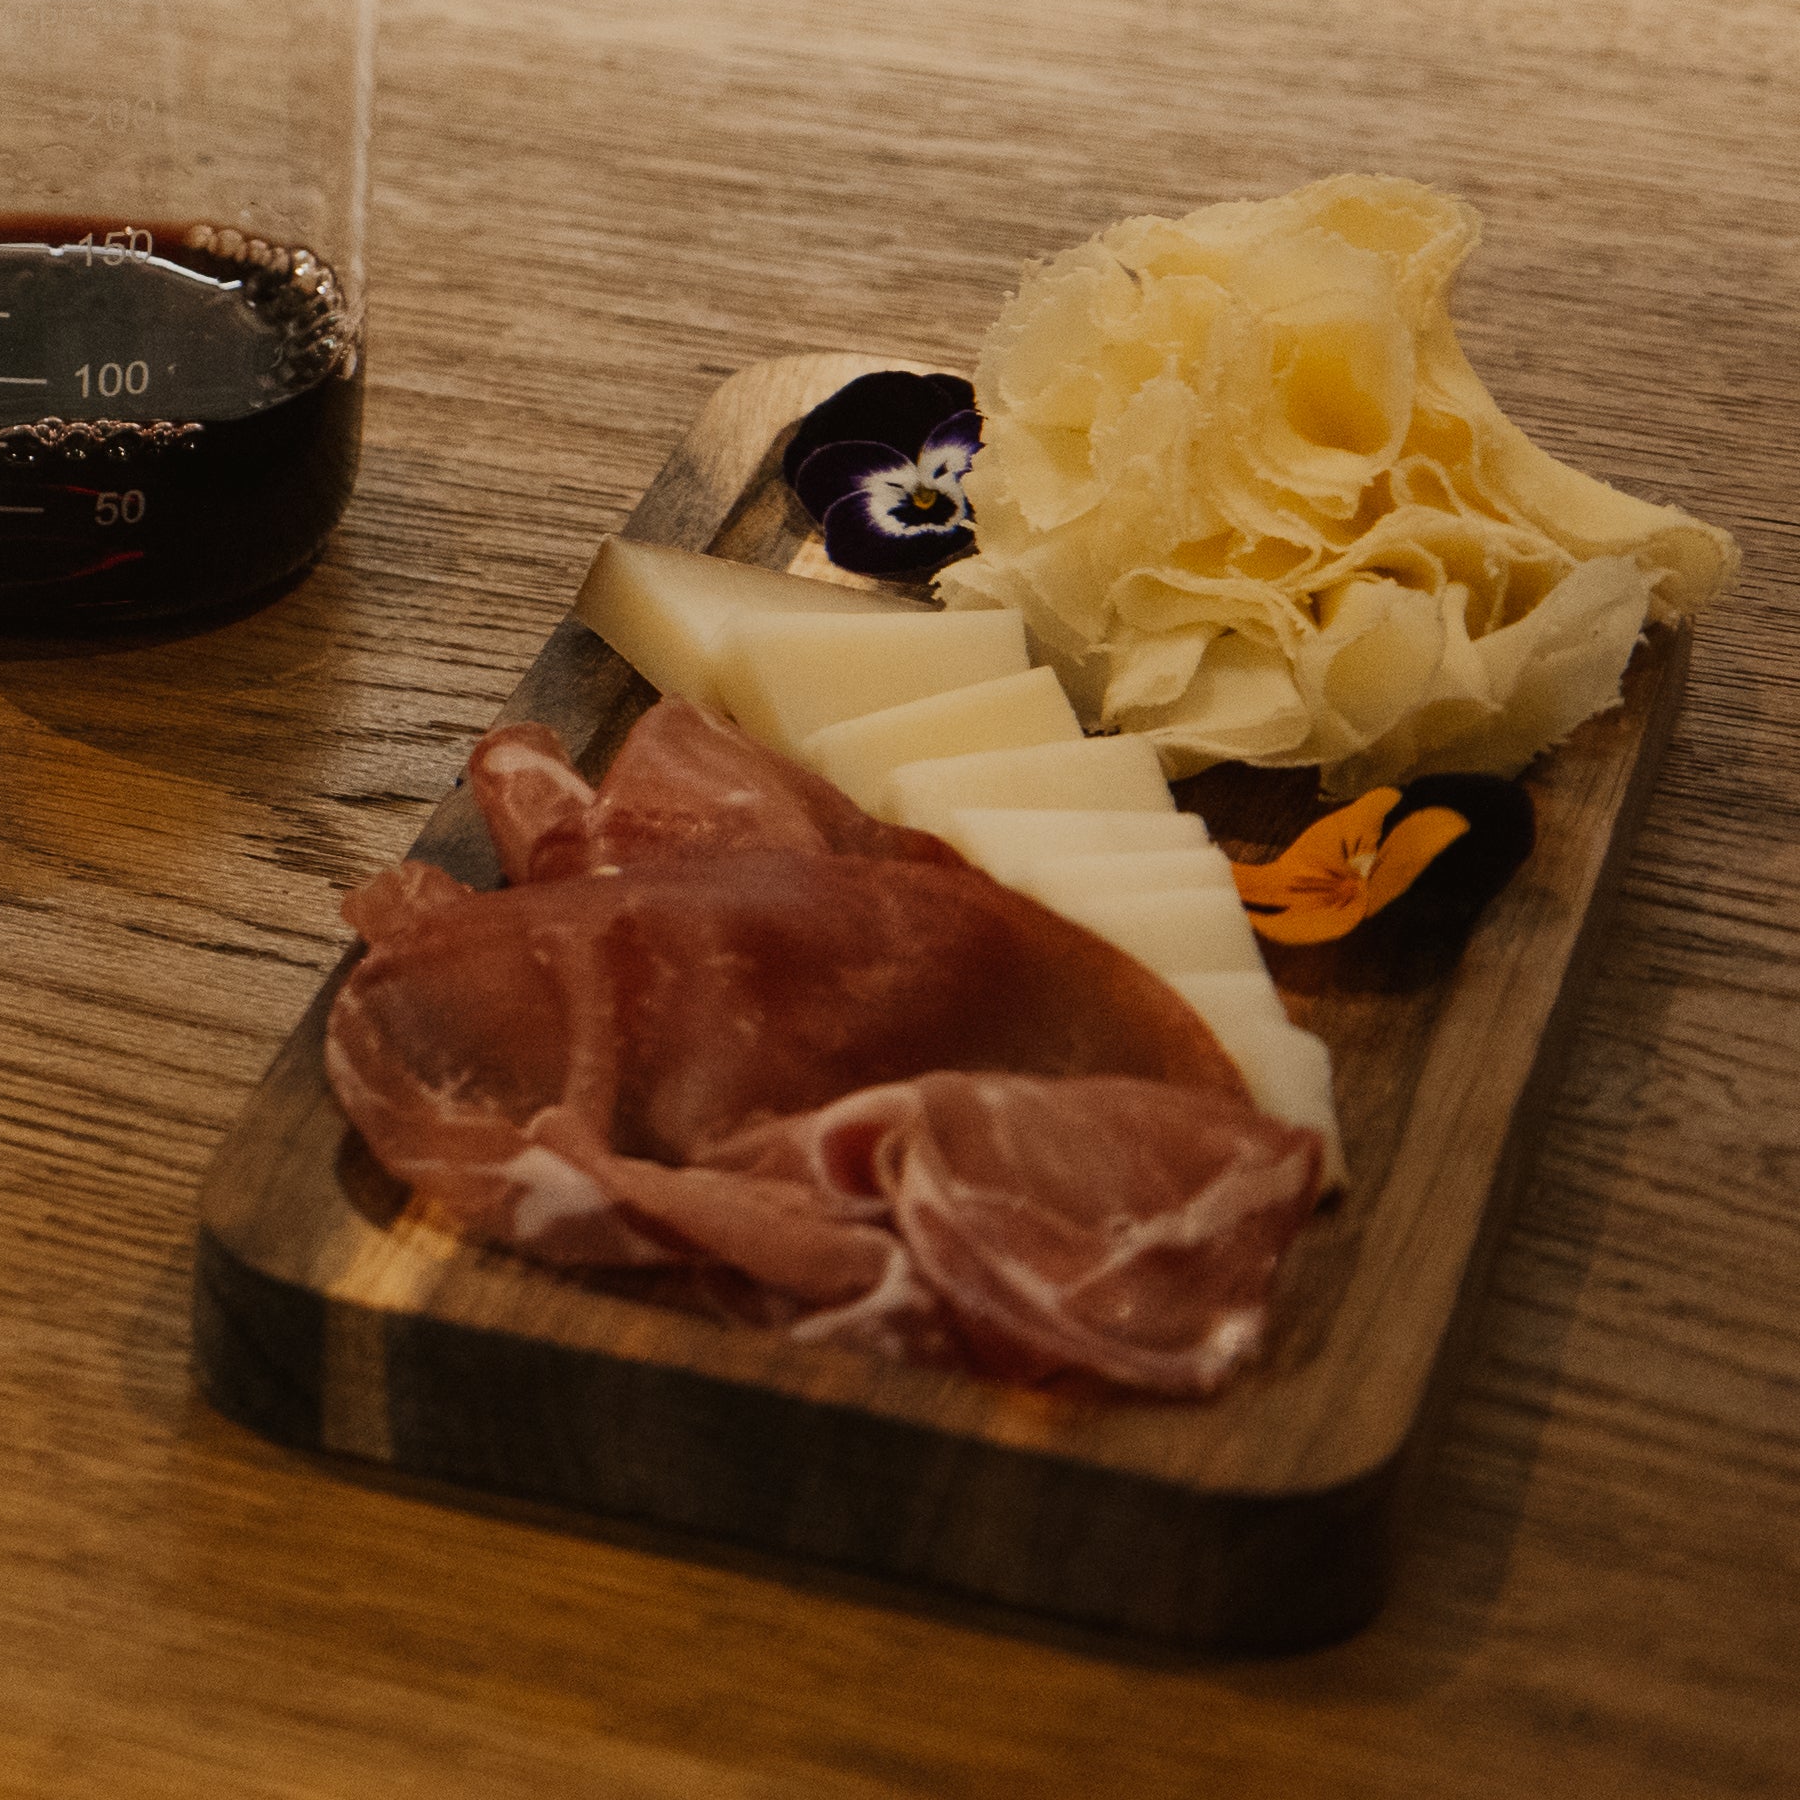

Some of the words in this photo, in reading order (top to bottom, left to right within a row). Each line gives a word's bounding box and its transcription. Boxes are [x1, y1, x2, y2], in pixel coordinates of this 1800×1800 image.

[79, 229, 153, 267] 150
[74, 361, 150, 399] 100
[94, 490, 146, 526] 50
